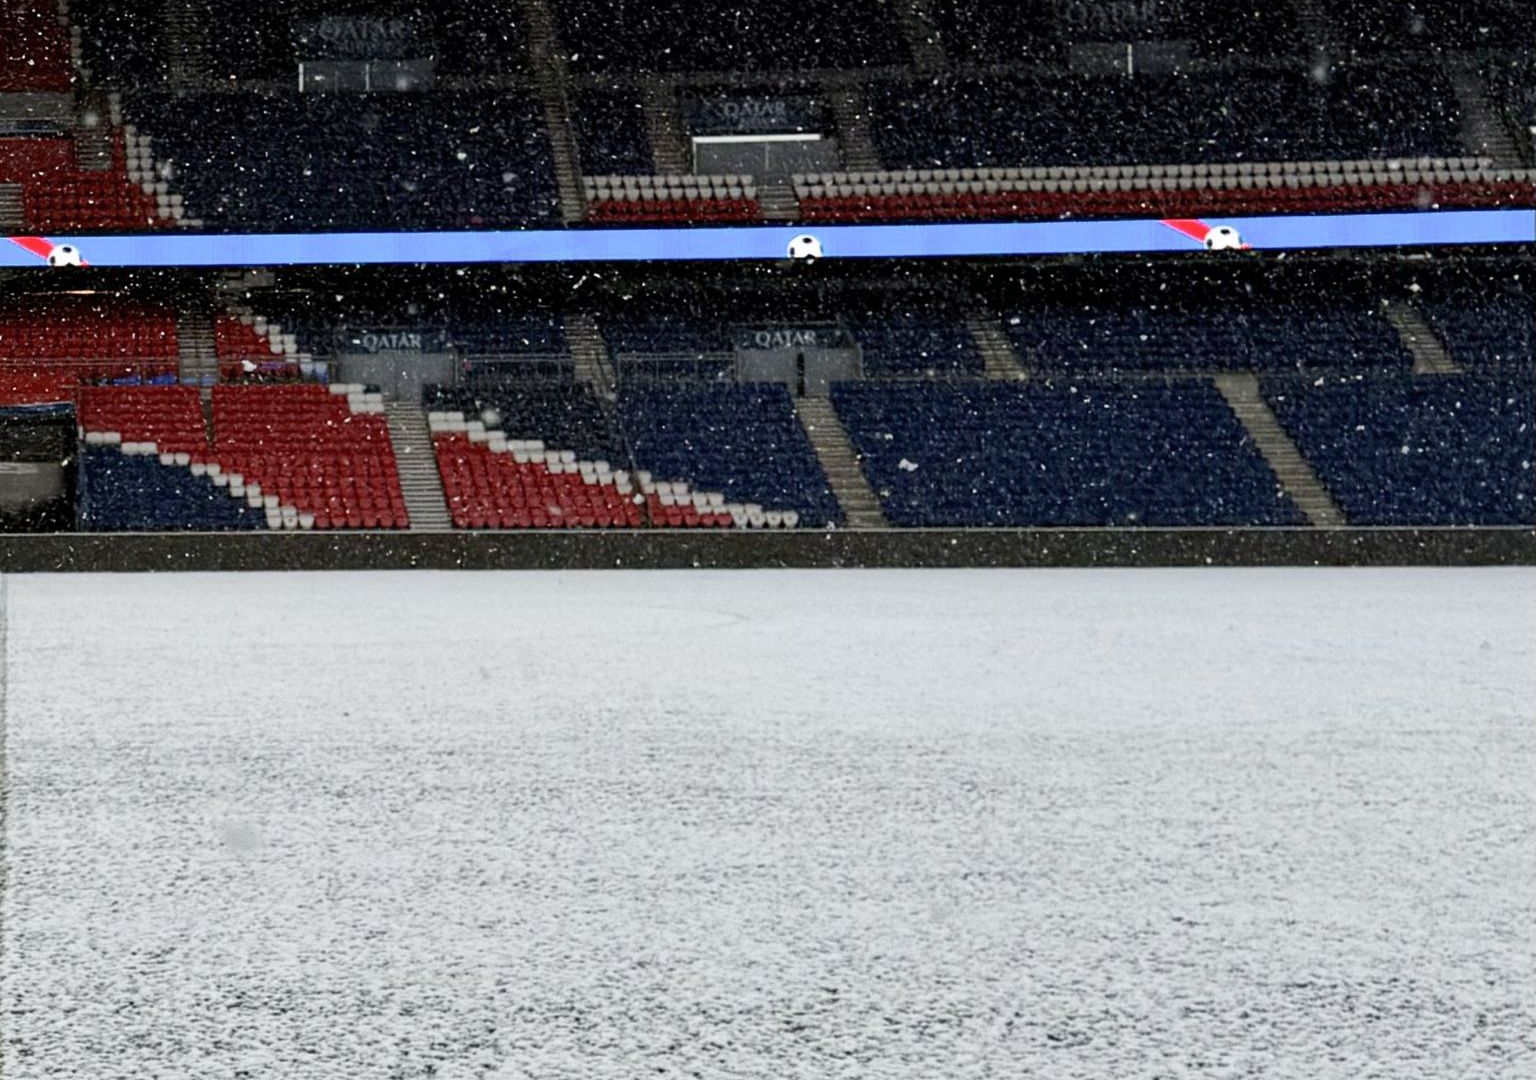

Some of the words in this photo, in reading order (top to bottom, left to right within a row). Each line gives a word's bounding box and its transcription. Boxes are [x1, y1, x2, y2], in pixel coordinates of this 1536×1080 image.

[723, 101, 787, 119] QATAR
[364, 332, 421, 352] QATAR
[755, 330, 816, 348] QATAR
